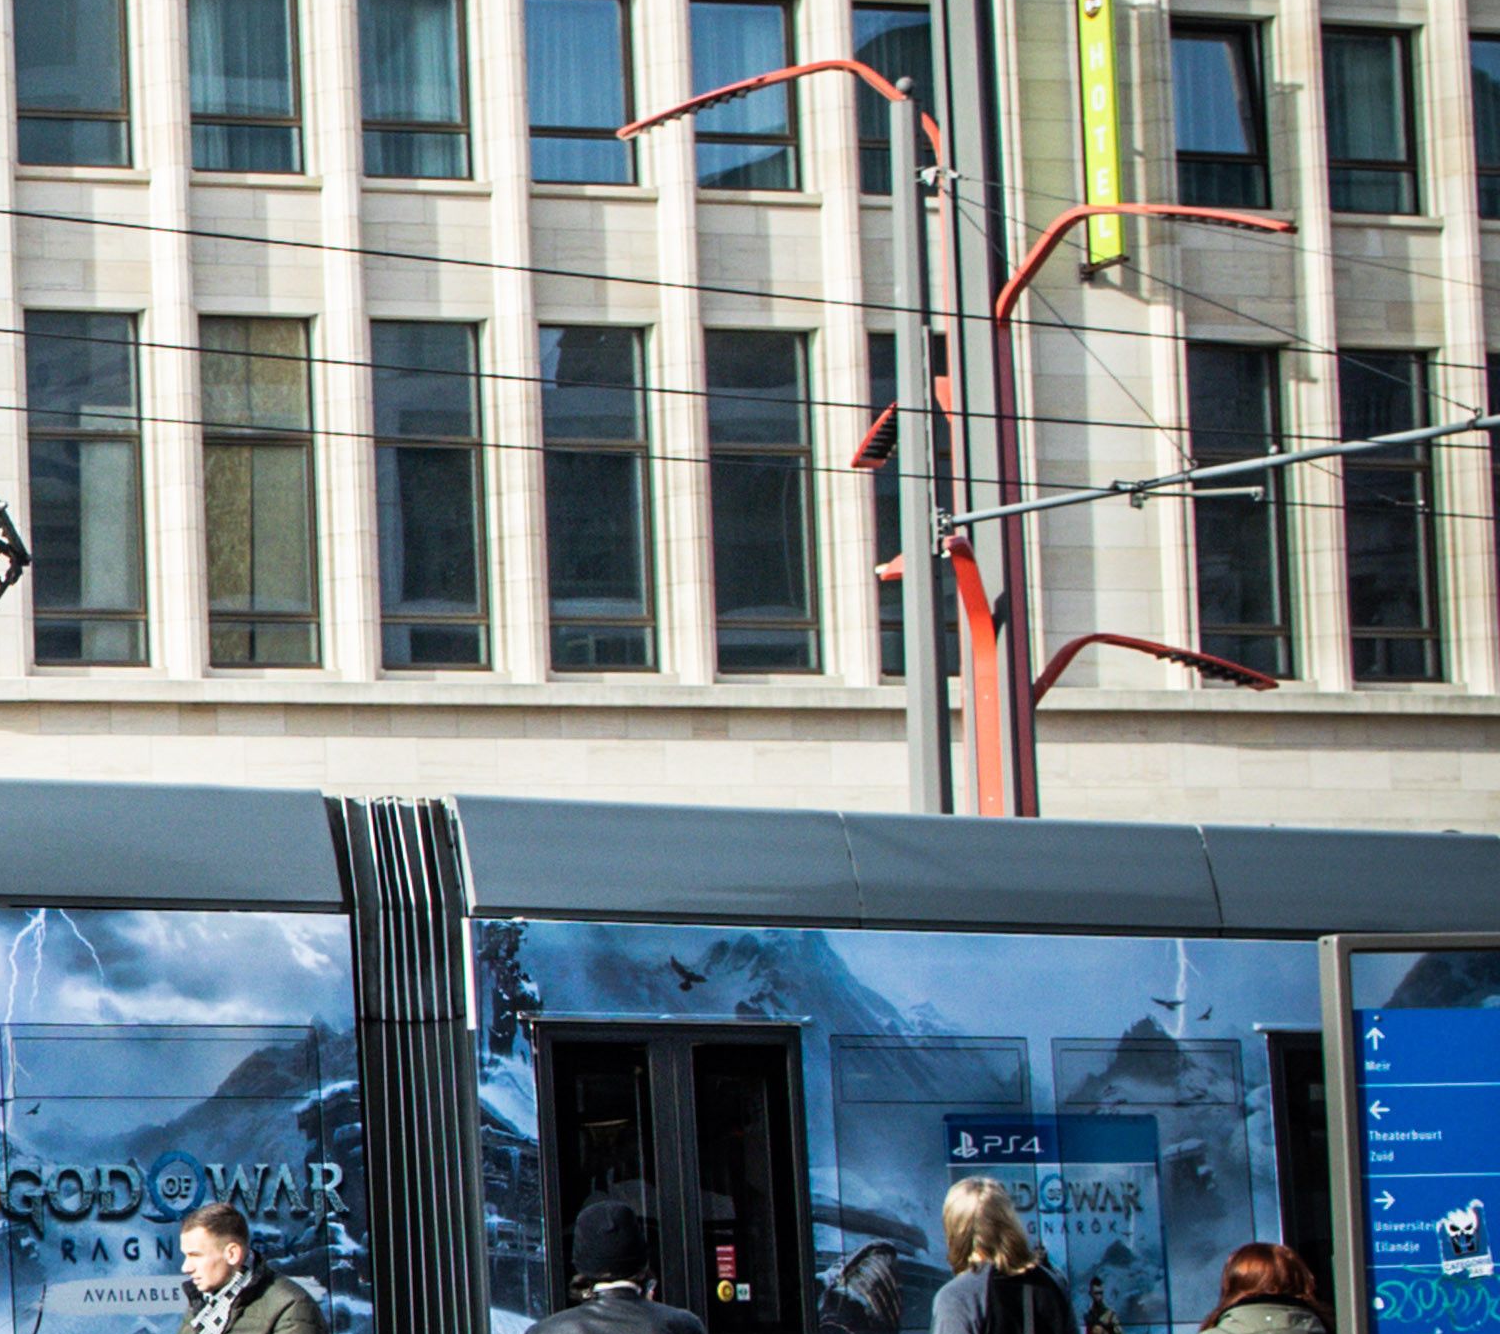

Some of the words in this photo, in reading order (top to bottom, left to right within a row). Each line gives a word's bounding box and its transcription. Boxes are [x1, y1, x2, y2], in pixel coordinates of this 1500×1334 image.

[1088, 42, 1113, 239] HOTEL
[983, 1135, 1042, 1154] PS4
[1369, 1129, 1442, 1142] Theaterbuurt
[0, 1161, 147, 1240] GOD
[162, 1176, 192, 1198] OF
[205, 1162, 350, 1233] WAR
[83, 1286, 181, 1305] AVAILABLE
